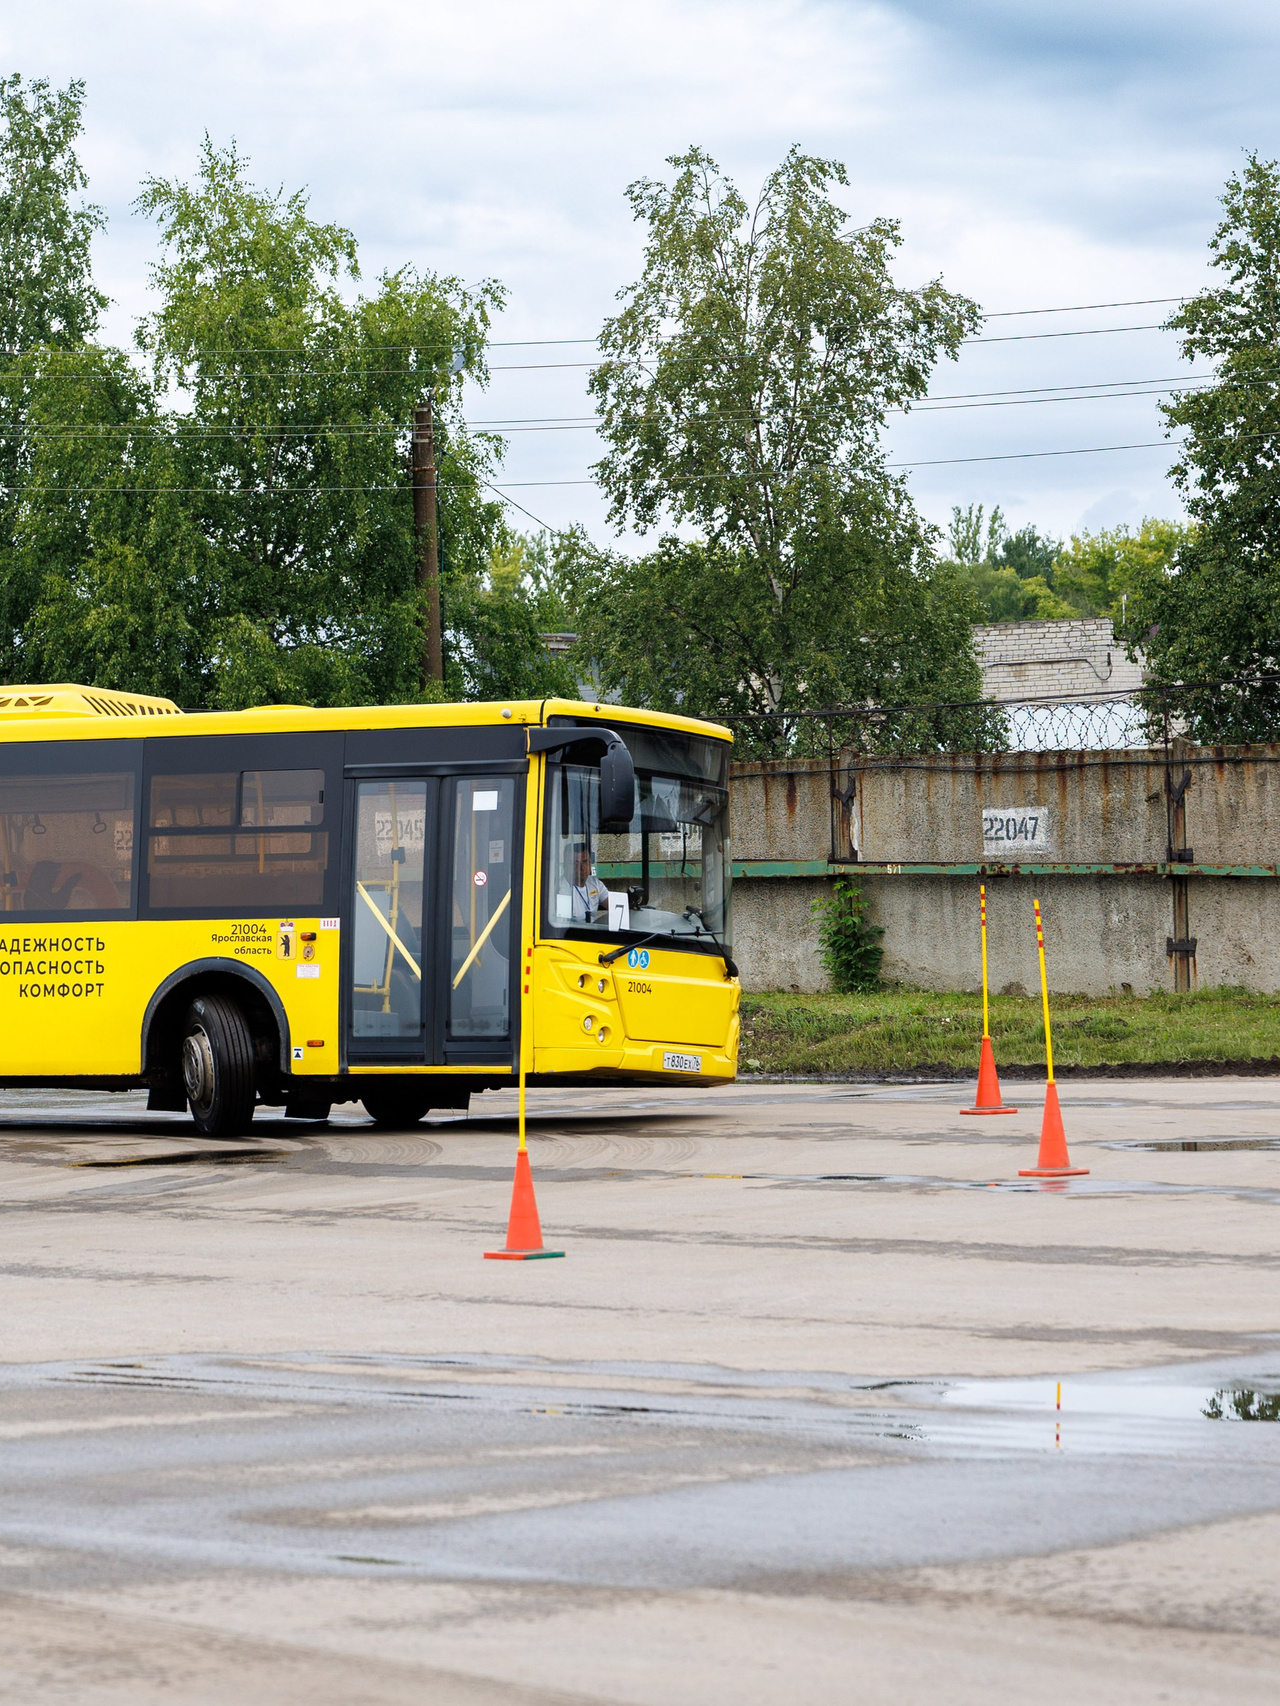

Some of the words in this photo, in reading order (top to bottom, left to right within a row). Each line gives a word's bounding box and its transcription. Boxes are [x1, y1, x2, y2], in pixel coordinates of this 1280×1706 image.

[983, 816, 1039, 841] 22047
[231, 923, 267, 935] 21004
[211, 934, 272, 944] Ярославская
[234, 946, 272, 955] область
[19, 983, 105, 998] КОМФОРТ
[627, 982, 653, 994] 21004
